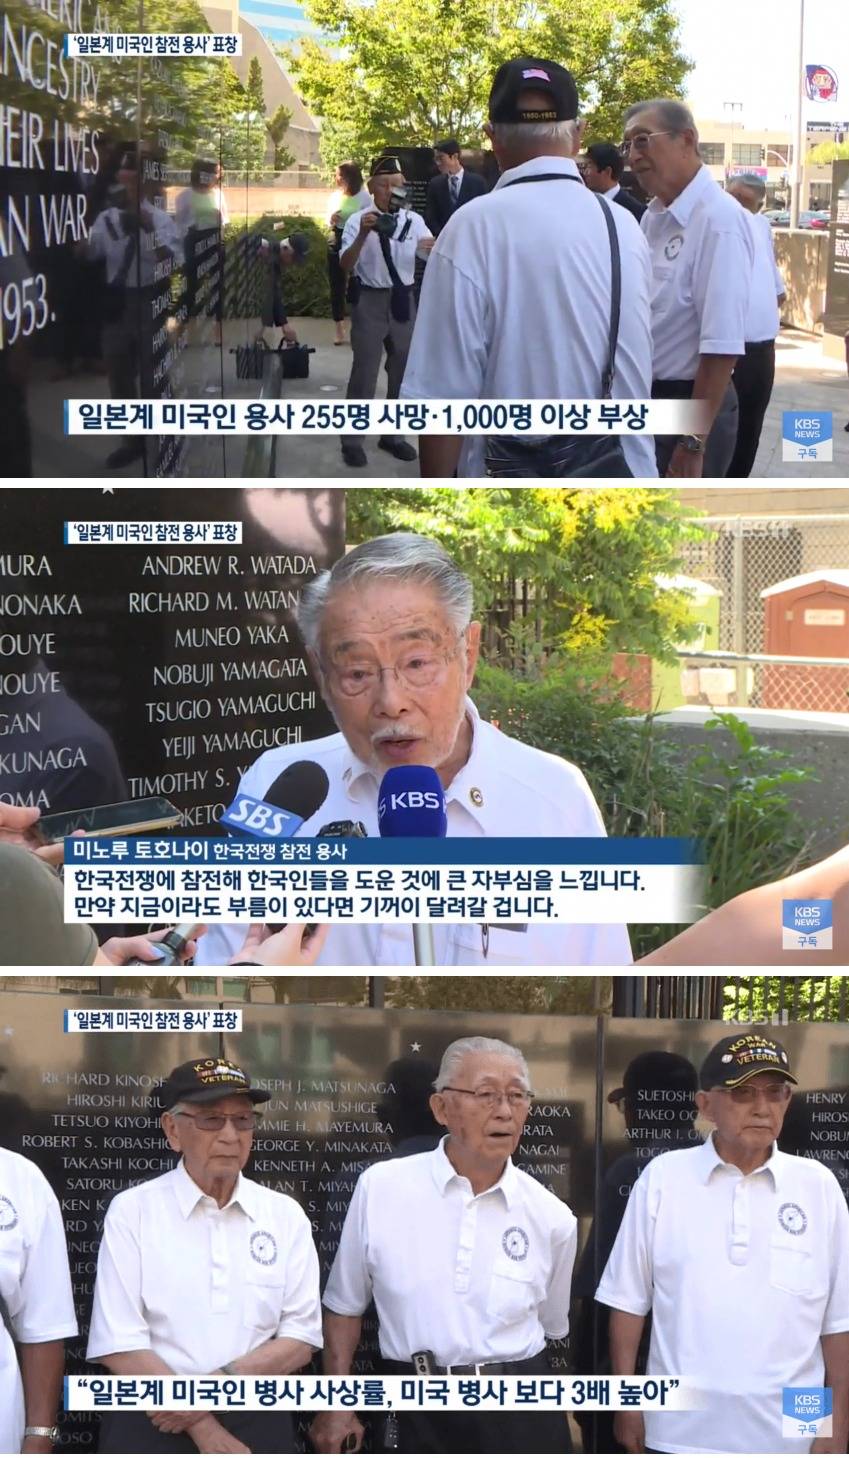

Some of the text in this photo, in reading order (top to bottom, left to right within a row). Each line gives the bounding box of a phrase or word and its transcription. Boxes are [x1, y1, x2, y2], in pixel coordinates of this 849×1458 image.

[0, 13, 100, 104] NCESTRY
[54, 119, 100, 175] LIVES
[142, 556, 317, 575] ANDREW R. WATADA
[129, 592, 238, 613] RICHARD M.
[175, 625, 289, 648] MUNEO YAKA
[153, 658, 308, 686] NOBUJI YAMAGATA
[145, 691, 316, 723] TSUGIO YAMAGUCHI
[162, 725, 302, 760] YEIJI YAMAGUCHI
[391, 791, 440, 810] KBS
[228, 798, 291, 837] SBS
[729, 1035, 776, 1053] KOREAN
[736, 1053, 780, 1066] VETERAN
[311, 1081, 397, 1094] MATSUNAGA
[67, 1095, 125, 1108] HIROSHI
[806, 1092, 846, 1104] HENRY
[53, 1115, 109, 1128] TETSUO
[324, 1141, 392, 1153] MINAKATA
[519, 1144, 559, 1156] NAGAI
[62, 1157, 174, 1170] TAKASHI KOCHI
[254, 1159, 315, 1172] KENNETH
[67, 1178, 122, 1191] SATORU
